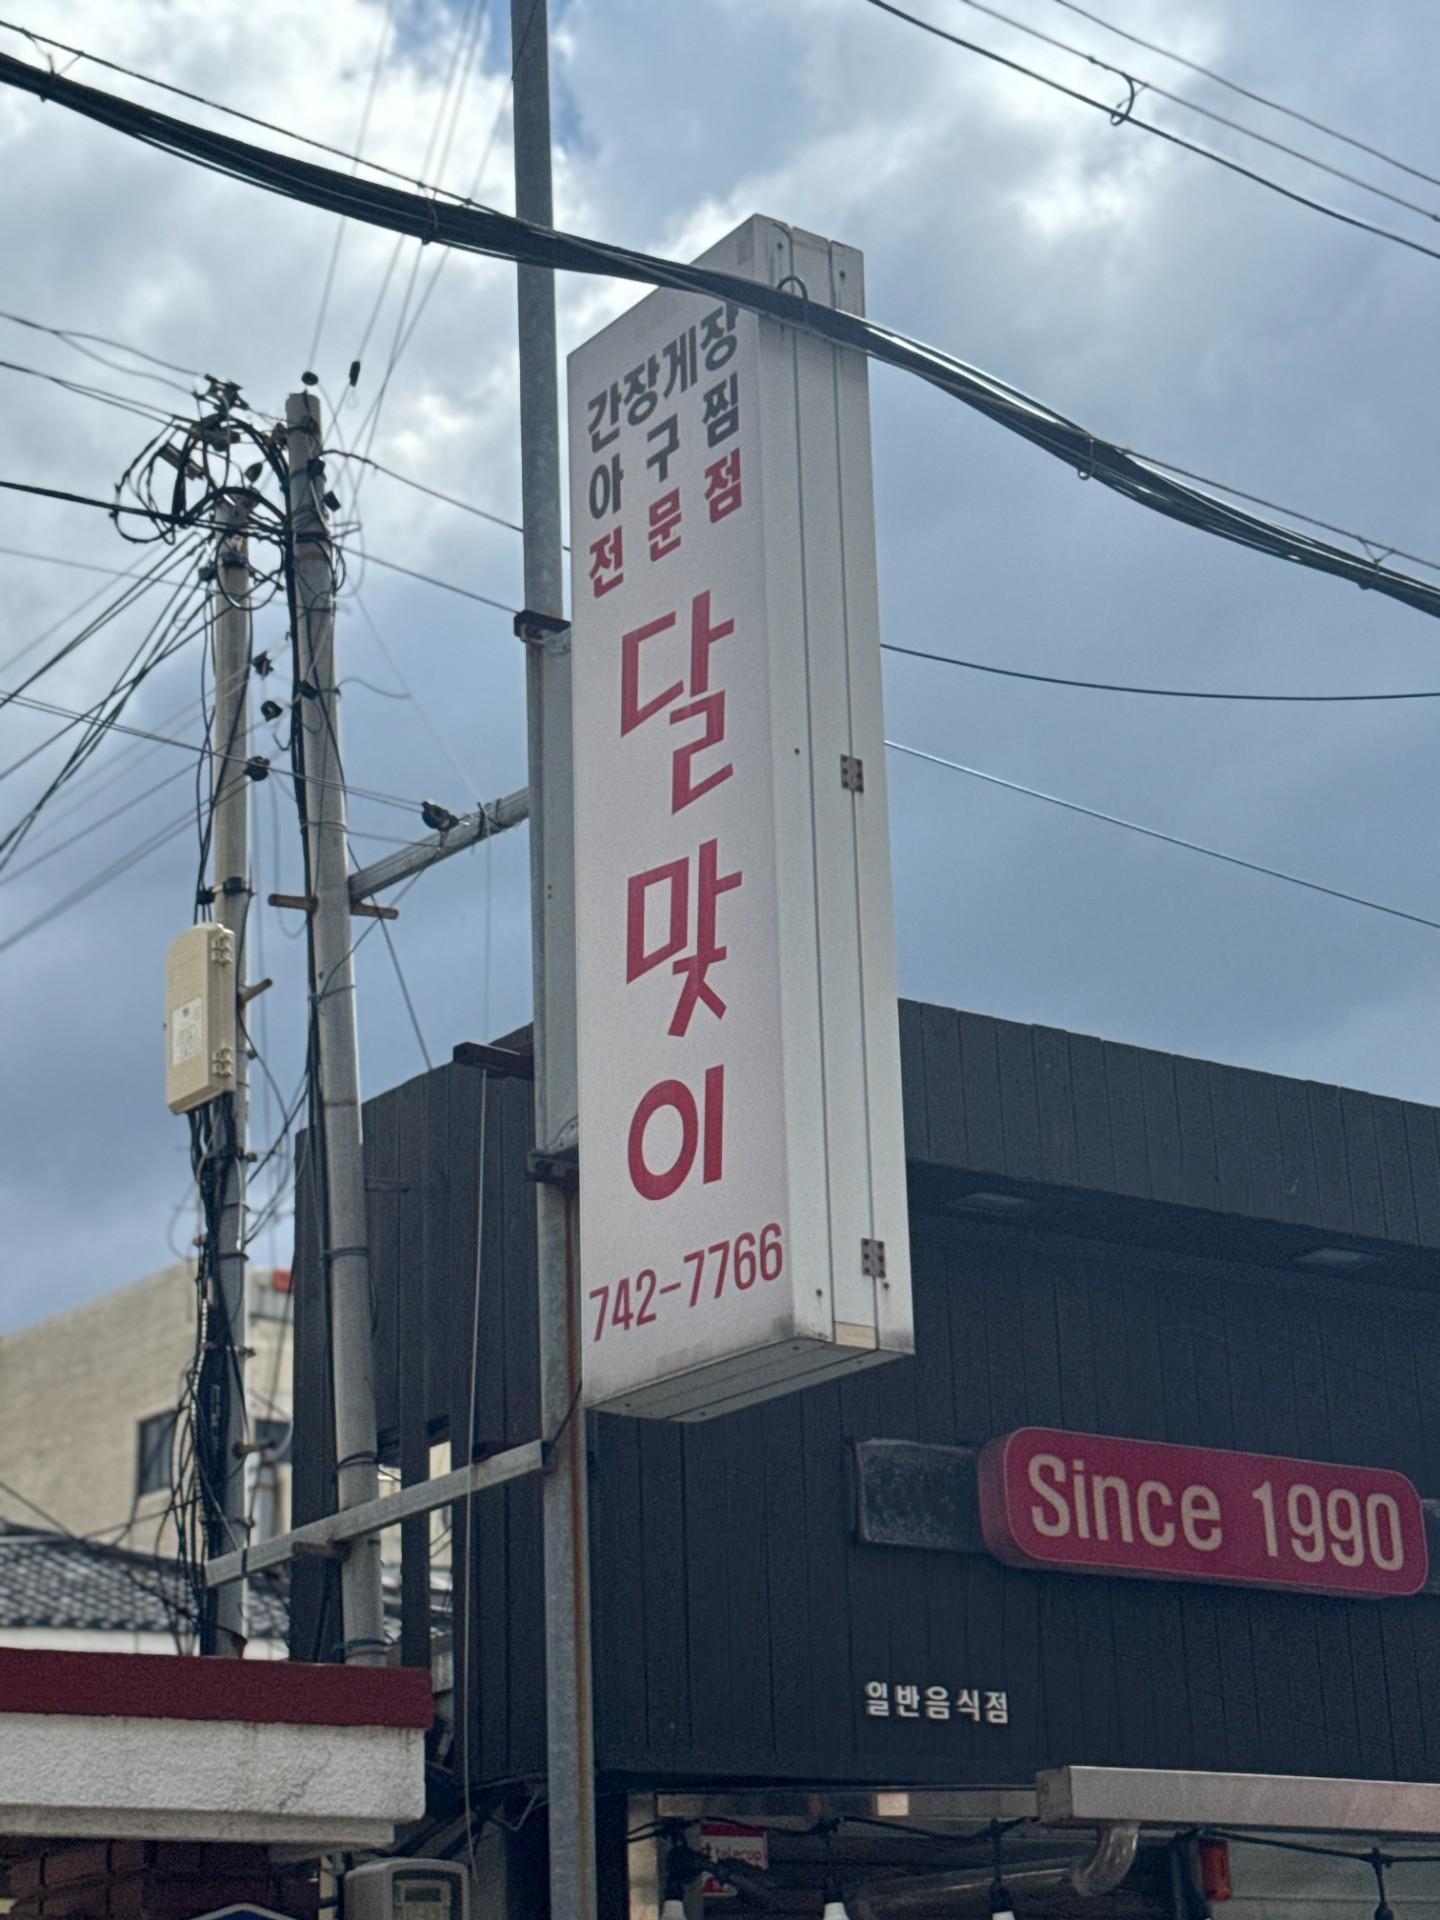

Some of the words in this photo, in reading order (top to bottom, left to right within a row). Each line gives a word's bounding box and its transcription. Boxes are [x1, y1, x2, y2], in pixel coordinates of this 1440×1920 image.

[587, 301, 739, 453] 간장게장
[589, 448, 742, 598] 전문점
[621, 590, 742, 1201] 달맞이
[589, 1222, 783, 1342] 742-7766
[1027, 1453, 1223, 1551] Since
[1252, 1480, 1405, 1572] 1990
[865, 1681, 1008, 1724] 일반음식점
